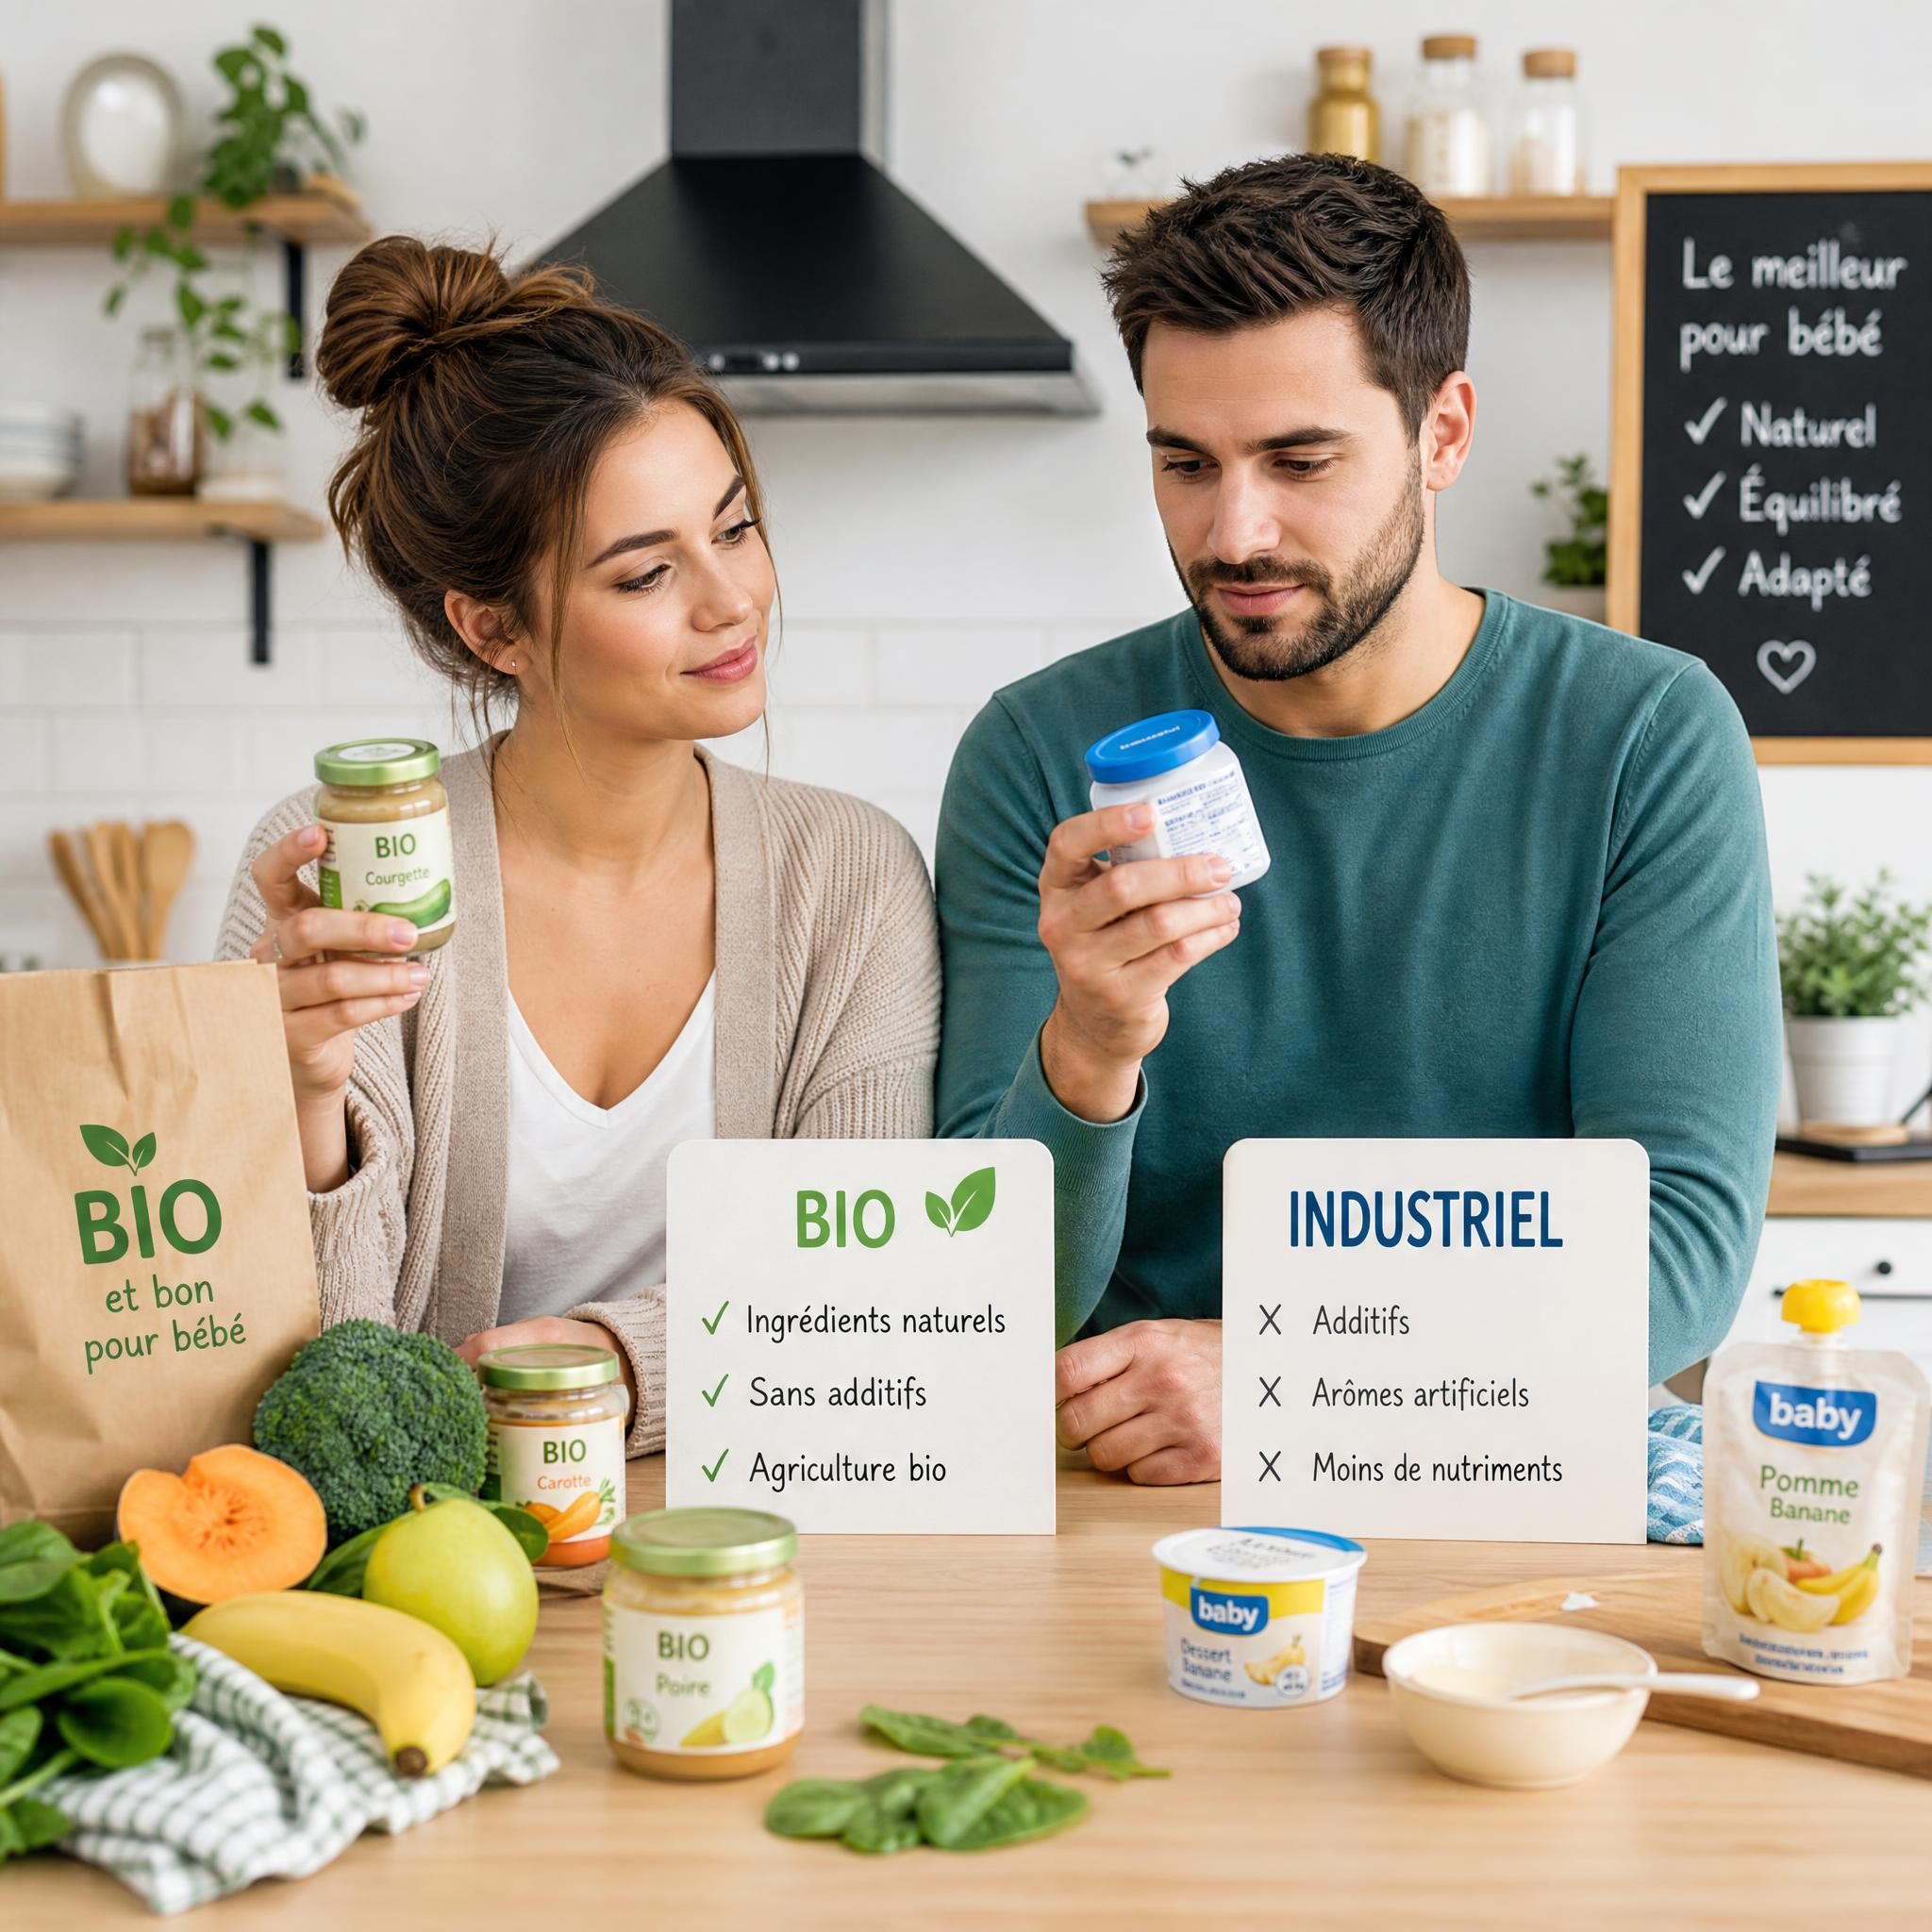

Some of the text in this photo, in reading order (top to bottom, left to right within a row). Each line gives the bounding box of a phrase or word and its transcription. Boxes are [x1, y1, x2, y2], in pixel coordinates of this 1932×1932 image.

[1682, 238, 1907, 289] Le meilleur
[1680, 307, 1883, 373] pour bébé
[1740, 402, 1877, 447] Naturel
[1740, 464, 1902, 536] Équilibré
[1738, 550, 1872, 611] Adapté
[375, 833, 416, 858] BIO
[365, 866, 430, 888] Courgette
[75, 1179, 222, 1264] BIO
[796, 1189, 895, 1248] BIO
[1290, 1190, 1563, 1248] INDUSTRIEL
[106, 1274, 214, 1313] et bon
[747, 1305, 1007, 1343] Ingrédients naturels
[1313, 1305, 1410, 1336] Additifs
[85, 1313, 246, 1375] pour bébé
[750, 1376, 927, 1409] Sans additifs
[1312, 1376, 1529, 1411] Arômes artificiels
[1769, 1391, 1862, 1441] baby
[542, 1439, 587, 1464] BIO
[1313, 1452, 1563, 1482] Moins de nutriments
[537, 1474, 591, 1491] Carotte
[749, 1452, 947, 1492] Agriculture bio
[1759, 1465, 1859, 1499] Pomme
[1770, 1497, 1851, 1525] Banane
[1198, 1595, 1259, 1631] baby
[657, 1631, 710, 1660] BIO
[656, 1673, 710, 1697] Poire
